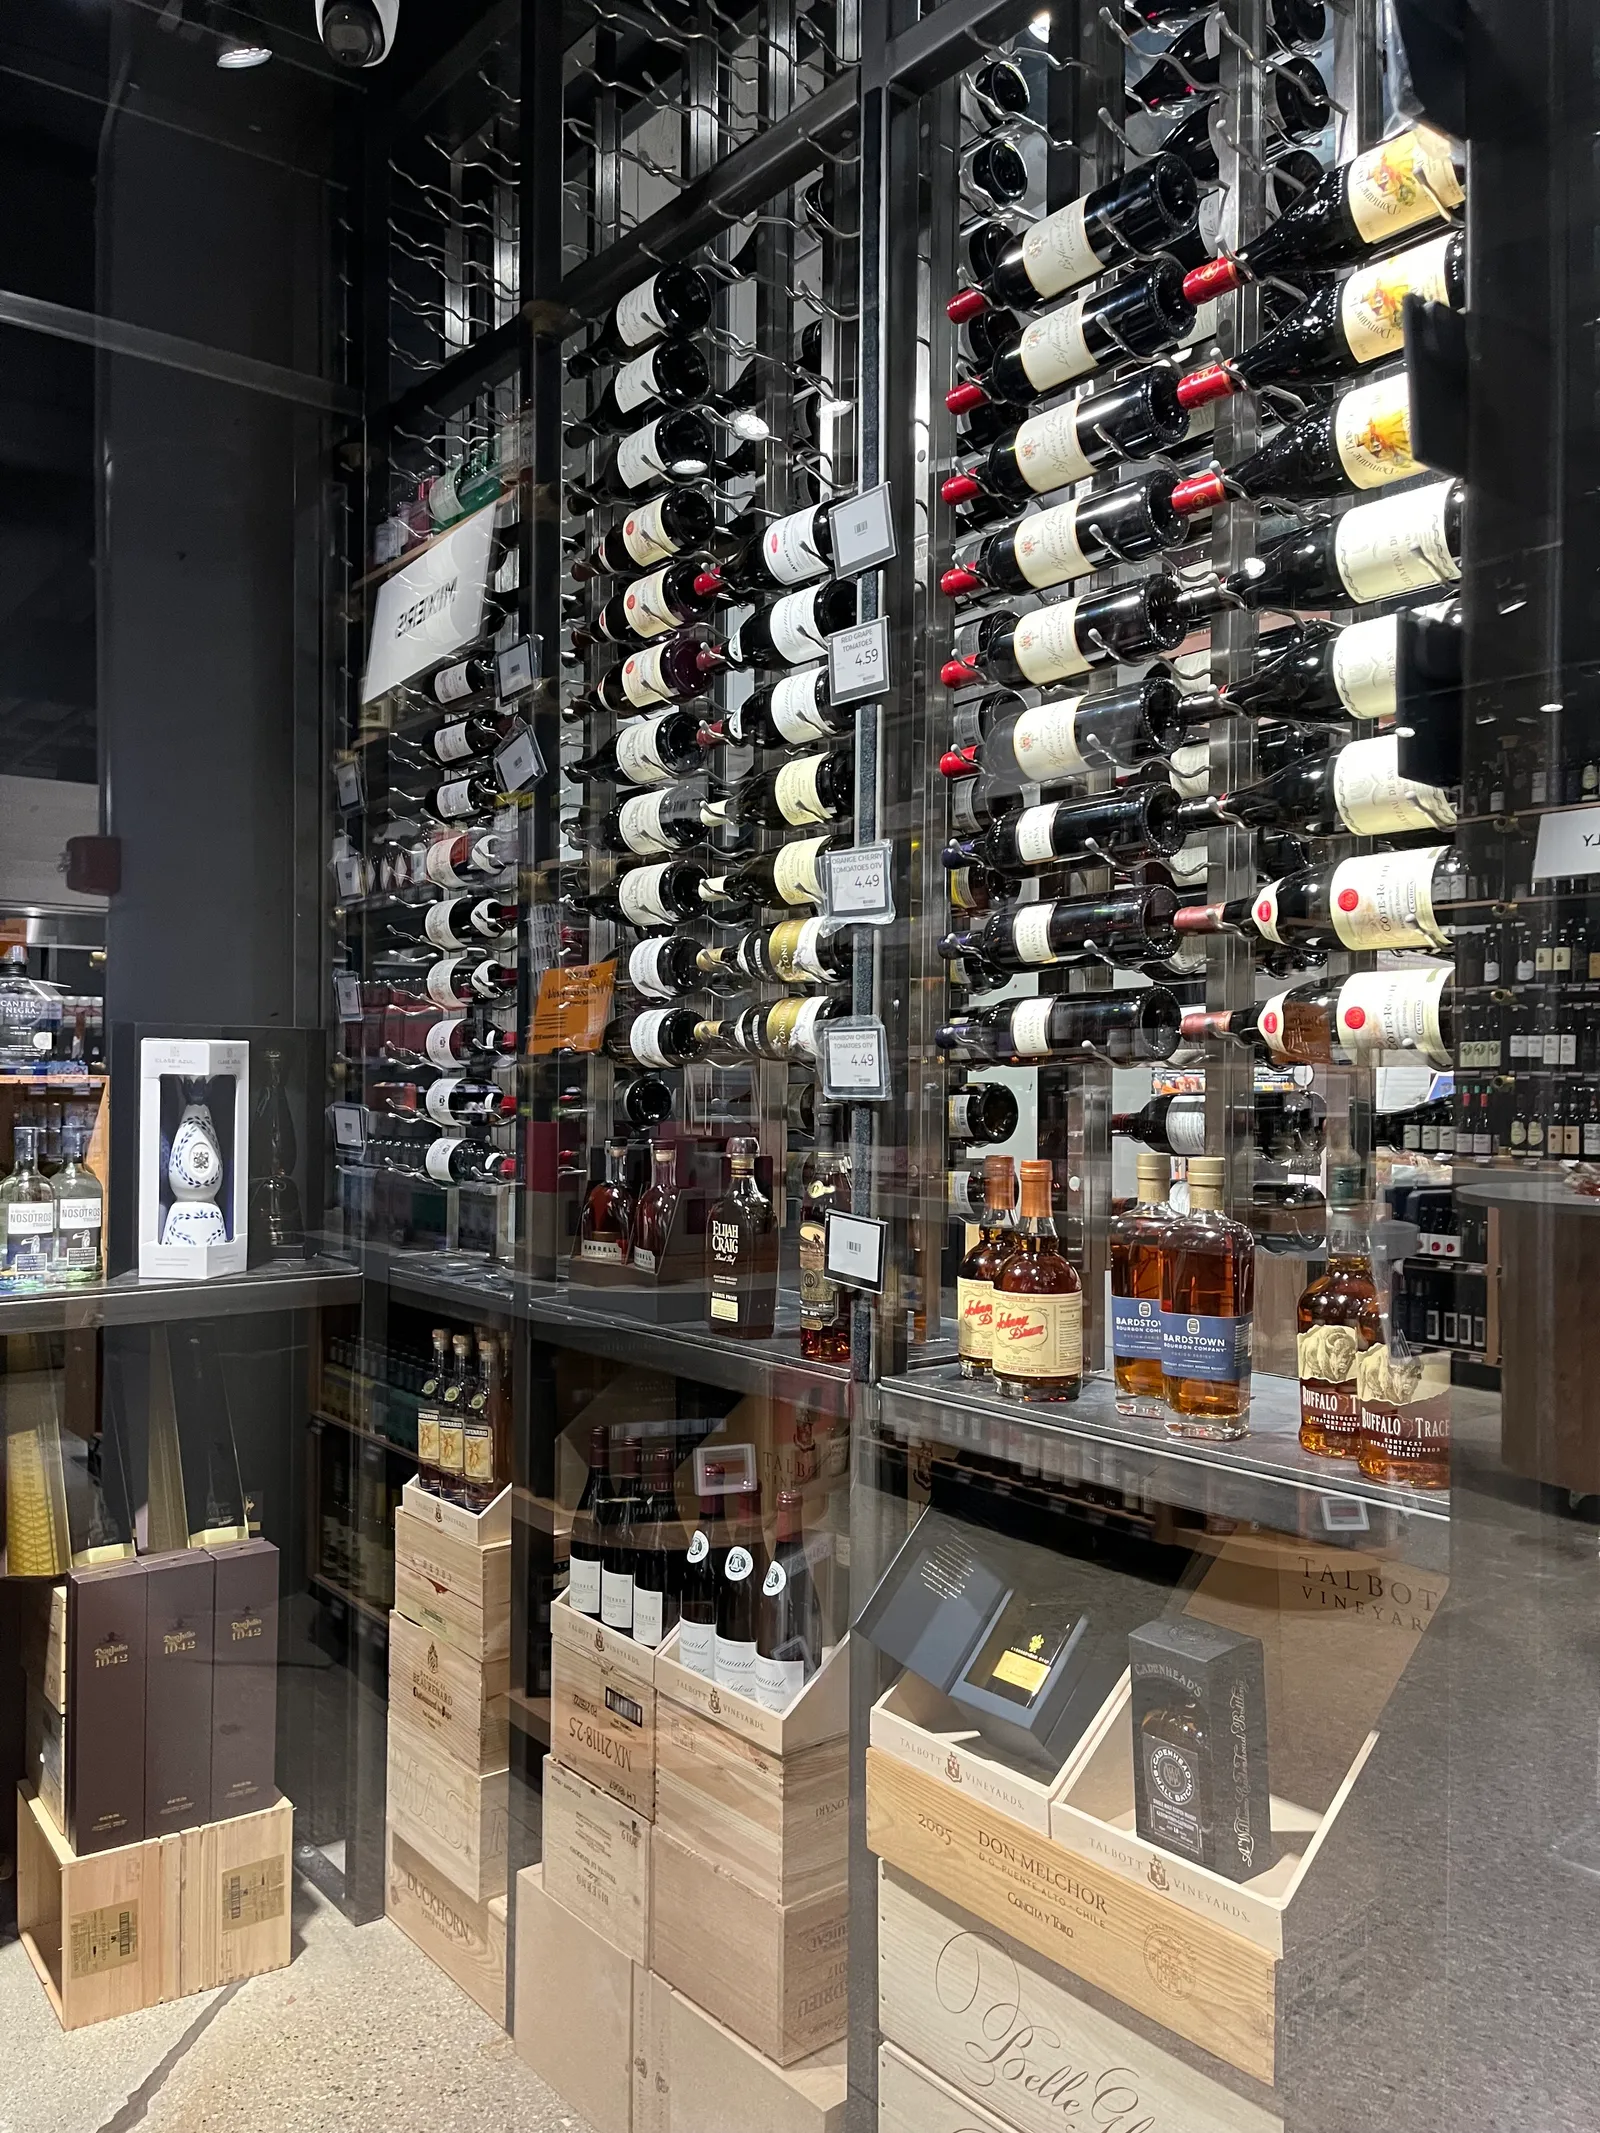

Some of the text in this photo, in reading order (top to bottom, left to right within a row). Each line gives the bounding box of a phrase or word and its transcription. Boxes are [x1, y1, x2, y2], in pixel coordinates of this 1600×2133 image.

[841, 628, 873, 644] RED GRAPE
[842, 638, 873, 652] TOMATOES
[855, 648, 879, 666] 4.59
[832, 853, 883, 865] ORANGE CHERRY
[854, 874, 880, 888] 4.49
[850, 1053, 874, 1067] 4.49
[10, 1212, 52, 1223] NOSOTROS
[62, 1207, 101, 1218] NOSOTROS
[712, 1220, 739, 1238] ELIJAH
[712, 1235, 739, 1254] CRAIG
[1008, 1325, 1044, 1341] Drum
[1163, 1333, 1225, 1346] BARDSTOWN
[1302, 1385, 1338, 1411] BUFFALO
[1310, 1415, 1339, 1428] STRAIGHT
[1322, 1413, 1357, 1422] KENTUCKY
[1361, 1406, 1401, 1436] BUFFALO
[1325, 1424, 1355, 1433] WHISKEY
[1370, 1439, 1402, 1452] STRAIGHT
[1384, 1437, 1423, 1447] KENTUCKY
[1387, 1449, 1421, 1458] WHISKEY
[568, 1622, 640, 1666] TALBOTT VINEYARDS
[1134, 1662, 1204, 1697] CADENHEAD'S
[413, 1672, 452, 1706] BEAURENARD
[676, 1679, 765, 1731] TALBOTT VINEYARDS
[614, 1742, 633, 1772] MX
[1153, 1749, 1191, 1779] CADENHEAD
[899, 1736, 1022, 1810] TALBOTT VINEYARDS
[1153, 1769, 1193, 1802] SMALL BATCH
[917, 1813, 1109, 1916] 2005 DON MELCHOR
[1089, 1836, 1144, 1872] TALBOTT
[1173, 1879, 1247, 1923] VINEYARDS
[1001, 1864, 1037, 1892] PUENTE
[1041, 1886, 1066, 1908] ALTO
[1075, 1905, 1106, 1929] CHILE
[407, 1871, 472, 1946] DUCKHORN
[421, 1905, 454, 1942] VINEYARDS
[1050, 1914, 1075, 1938] TORO
